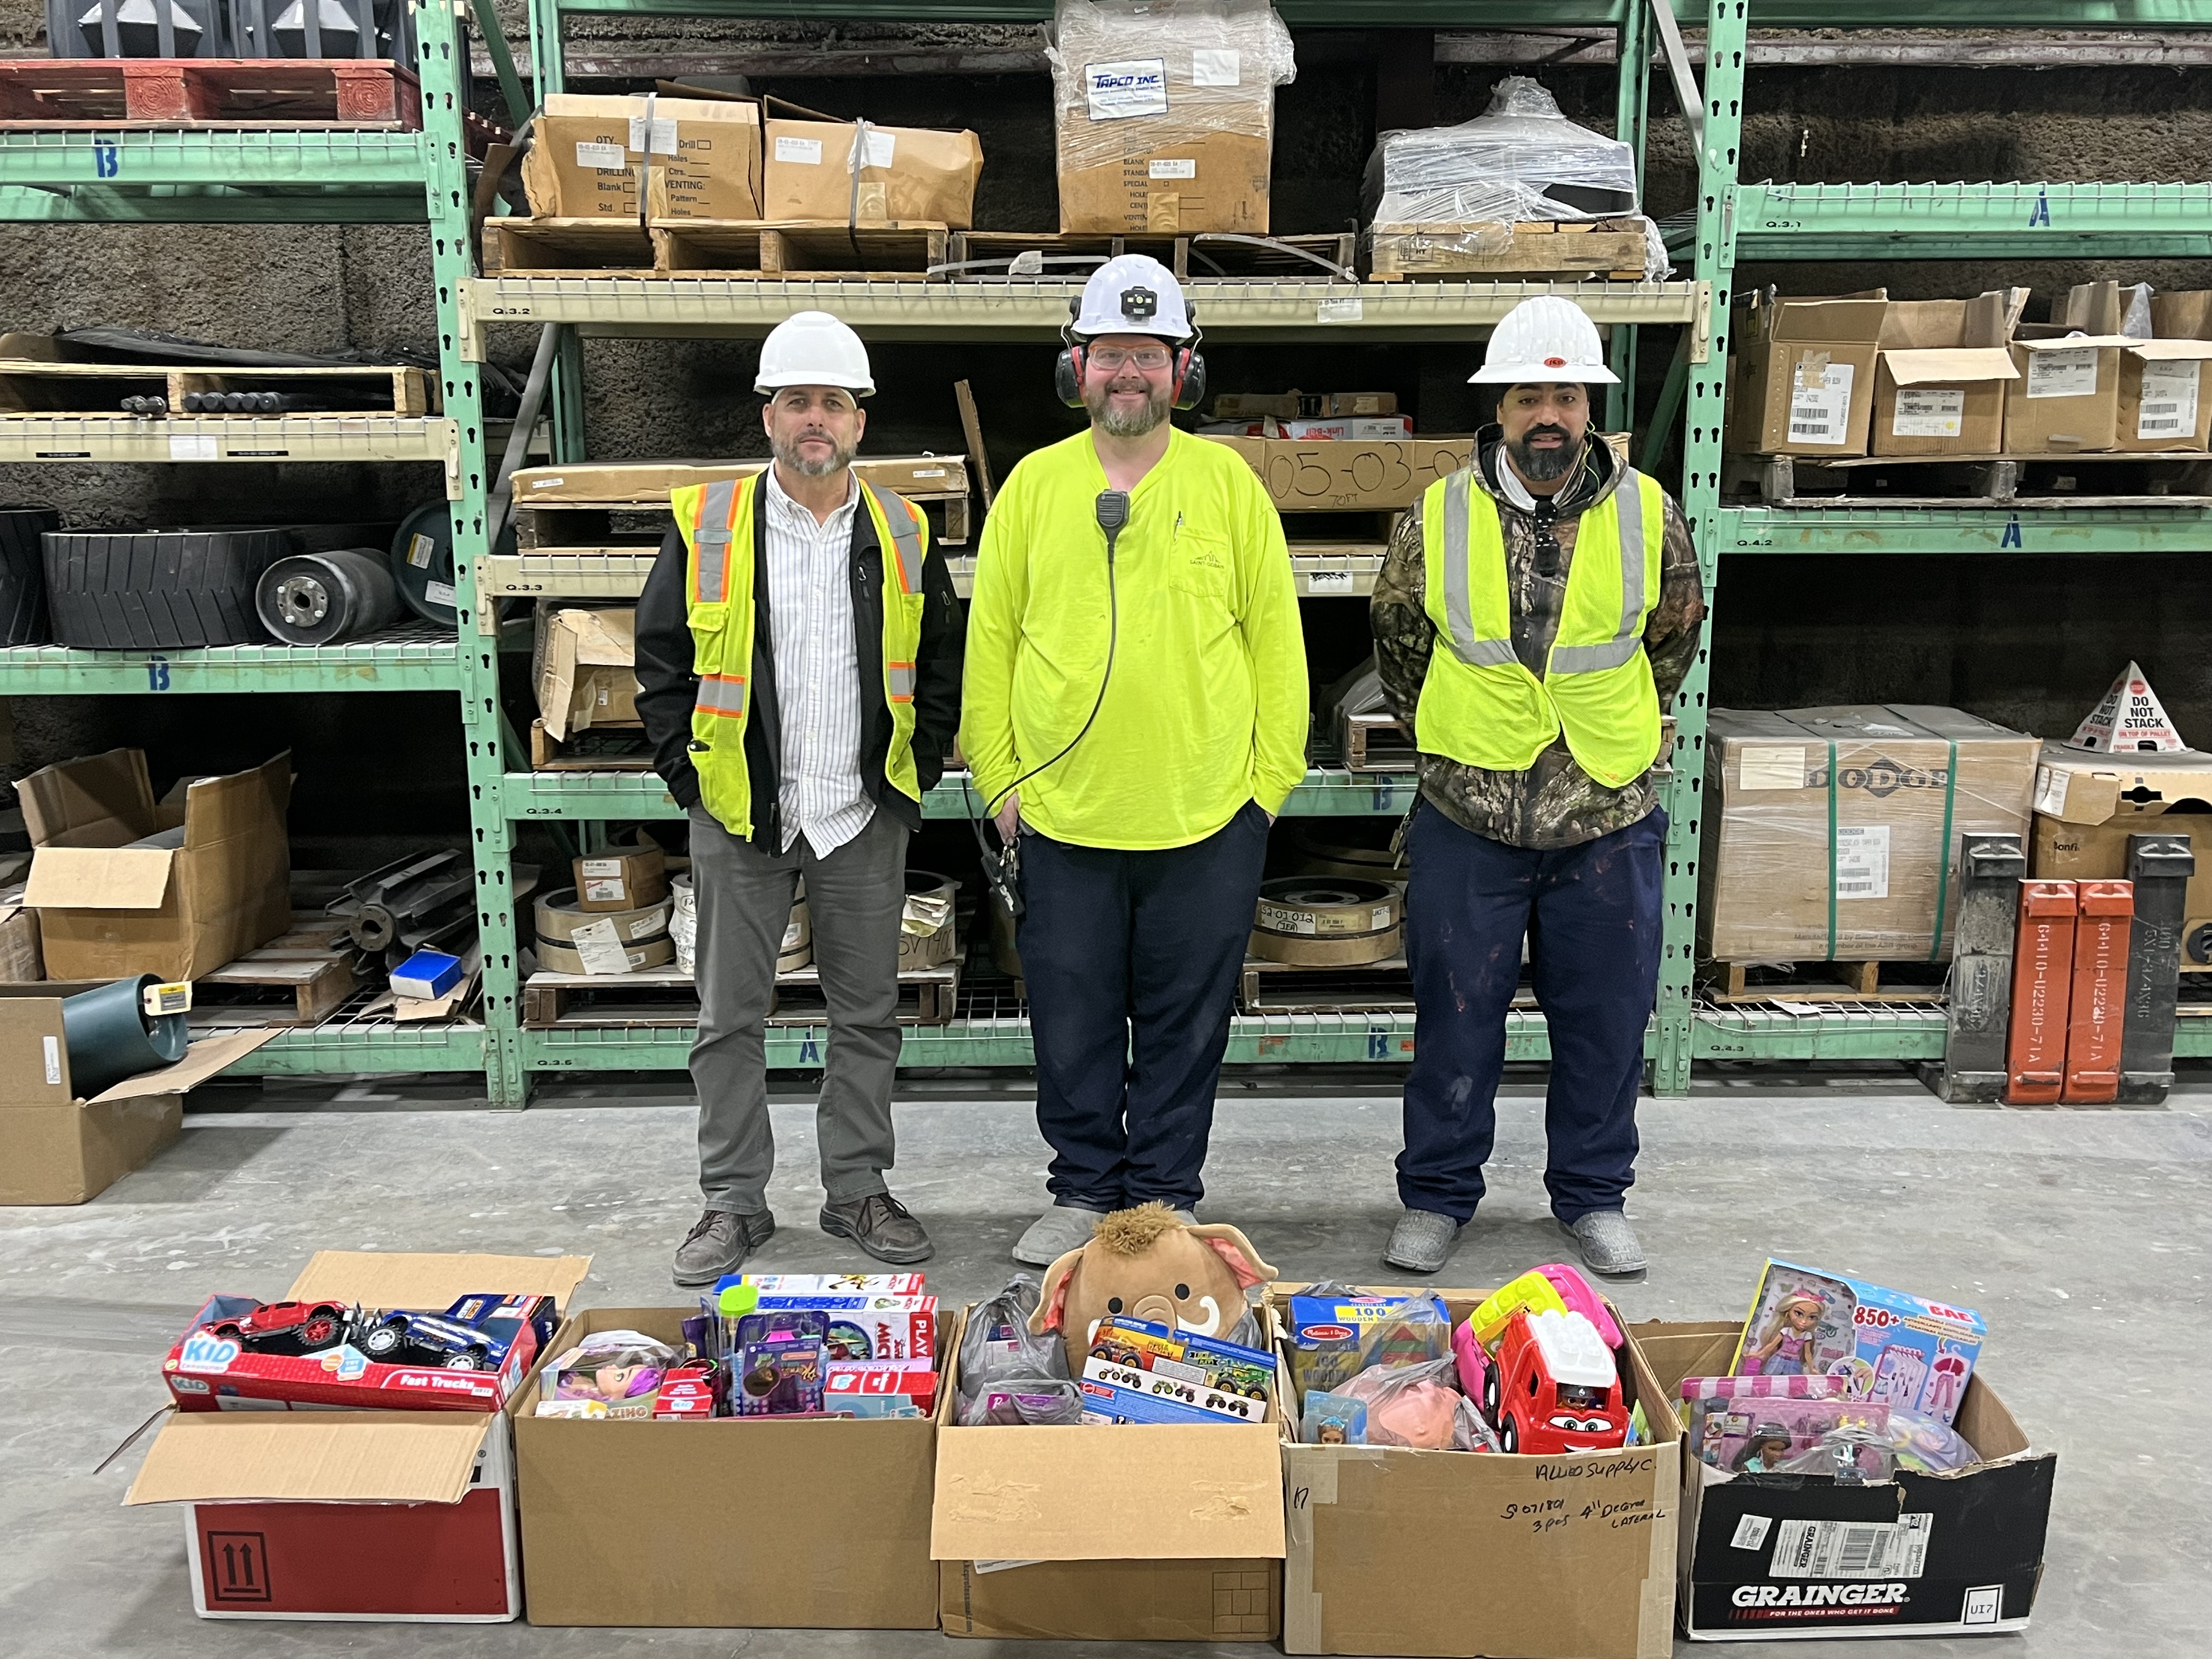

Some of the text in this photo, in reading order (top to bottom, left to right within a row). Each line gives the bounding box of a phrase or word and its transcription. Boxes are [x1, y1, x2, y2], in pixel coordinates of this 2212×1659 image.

[1092, 74, 1159, 88] TAPCO INC
[679, 140, 696, 149] Drill
[95, 139, 117, 178] B
[668, 154, 687, 162] Holes
[598, 182, 622, 191] Blank
[665, 180, 706, 189] VENTING:
[599, 204, 615, 212] Std.
[2029, 191, 2050, 227] A
[2001, 514, 2022, 548] A
[149, 656, 170, 690] B
[2106, 695, 2118, 705] DO
[2132, 697, 2148, 706] DO
[2099, 705, 2115, 715] NOT
[2130, 708, 2154, 717] NOT
[2125, 719, 2164, 728] STACK
[1373, 776, 1393, 810] B
[799, 1032, 820, 1063] A
[1369, 1027, 1389, 1059] B
[1355, 1308, 1386, 1316] 100
[1854, 1306, 1900, 1327] 850+
[184, 1340, 235, 1363] KID
[400, 1374, 475, 1390] Fast Trucks
[1800, 1526, 1815, 1568] GRAINGER
